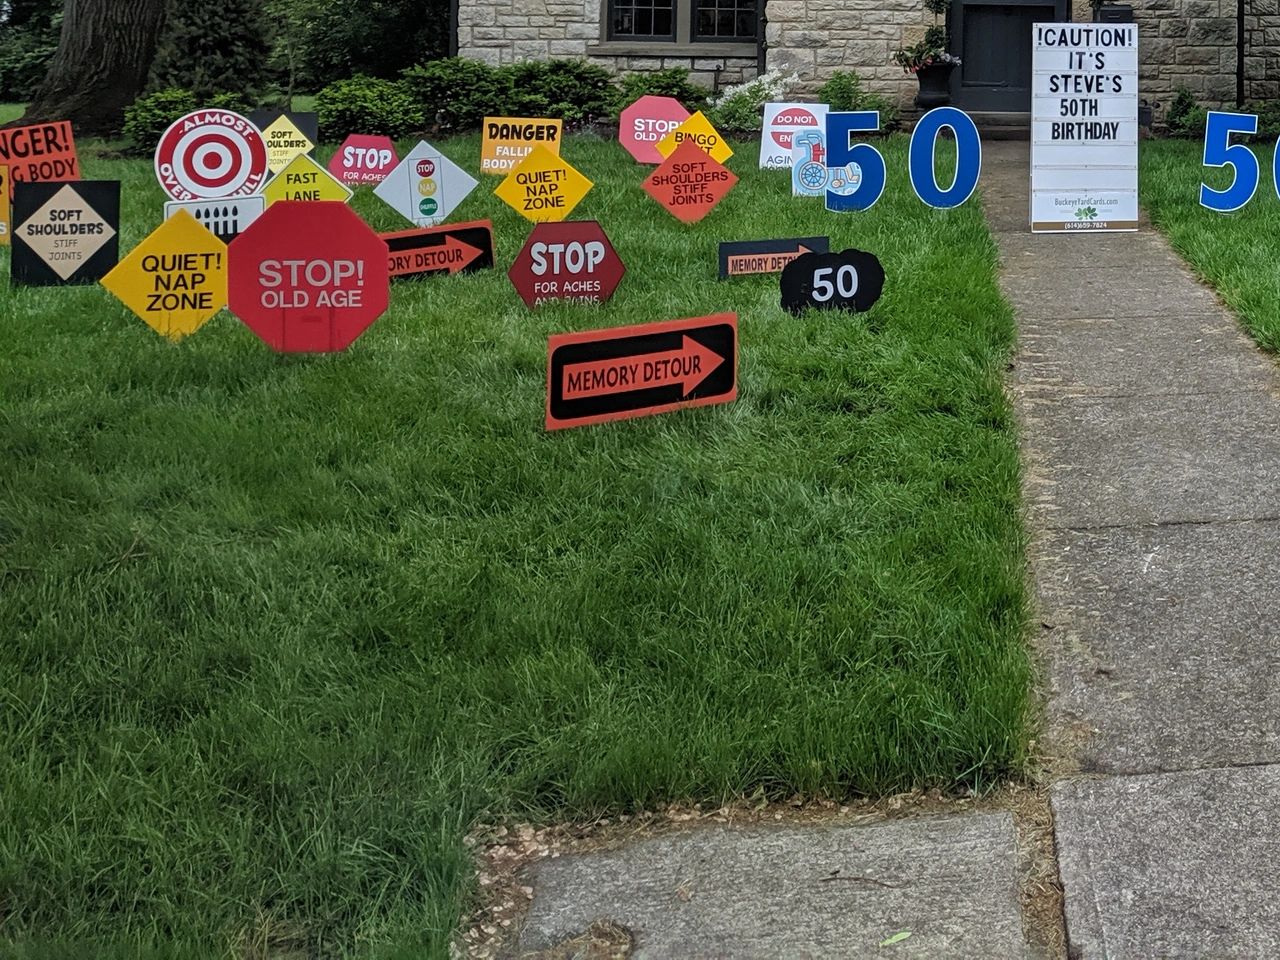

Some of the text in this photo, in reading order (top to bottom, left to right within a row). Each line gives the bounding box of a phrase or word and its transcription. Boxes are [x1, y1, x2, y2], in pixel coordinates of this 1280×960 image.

[1038, 28, 1132, 47] !CAUTION!
[1069, 51, 1105, 70] IT'S
[1049, 74, 1122, 93] STEVE'S
[1060, 98, 1098, 117] 50TH
[777, 115, 792, 123] DO
[271, 131, 293, 139] SOFT
[487, 123, 557, 142] DANGER
[634, 132, 656, 141] OLD
[1051, 122, 1119, 140] BIRTHDAY
[267, 140, 306, 148] OULDERS
[496, 146, 532, 157] FALLI
[343, 146, 392, 169] STOP
[483, 159, 515, 169] BODY
[766, 155, 792, 164] AGIN
[28, 158, 75, 182] BODY
[417, 164, 434, 173] STOP
[672, 162, 706, 174] SOFT
[286, 172, 318, 184] FAST
[343, 172, 359, 180] FOR
[516, 169, 567, 185] QUIET!
[652, 171, 728, 186] SHOULDERS
[286, 190, 320, 201] LANE
[526, 183, 558, 197] NAP
[673, 183, 708, 195] STIFF
[523, 195, 565, 211] ZONE
[669, 193, 714, 206] JOINTS
[49, 209, 82, 221] SOFT
[27, 223, 104, 236] SHOULDERS
[54, 239, 78, 248] STIFF
[49, 252, 82, 261] JOINTS
[141, 253, 221, 272] QUIET!
[388, 248, 463, 271] ORY DETOUR
[530, 241, 605, 276] STOP
[731, 255, 767, 271] MEMORY
[258, 259, 364, 287] STOP!
[154, 273, 205, 291] NAP
[534, 280, 600, 293] FOR ACHES
[812, 264, 858, 302] 50
[146, 292, 213, 311] ZONE
[261, 290, 362, 309] OLD AGE
[567, 354, 702, 393] MEMORY DETOUR
